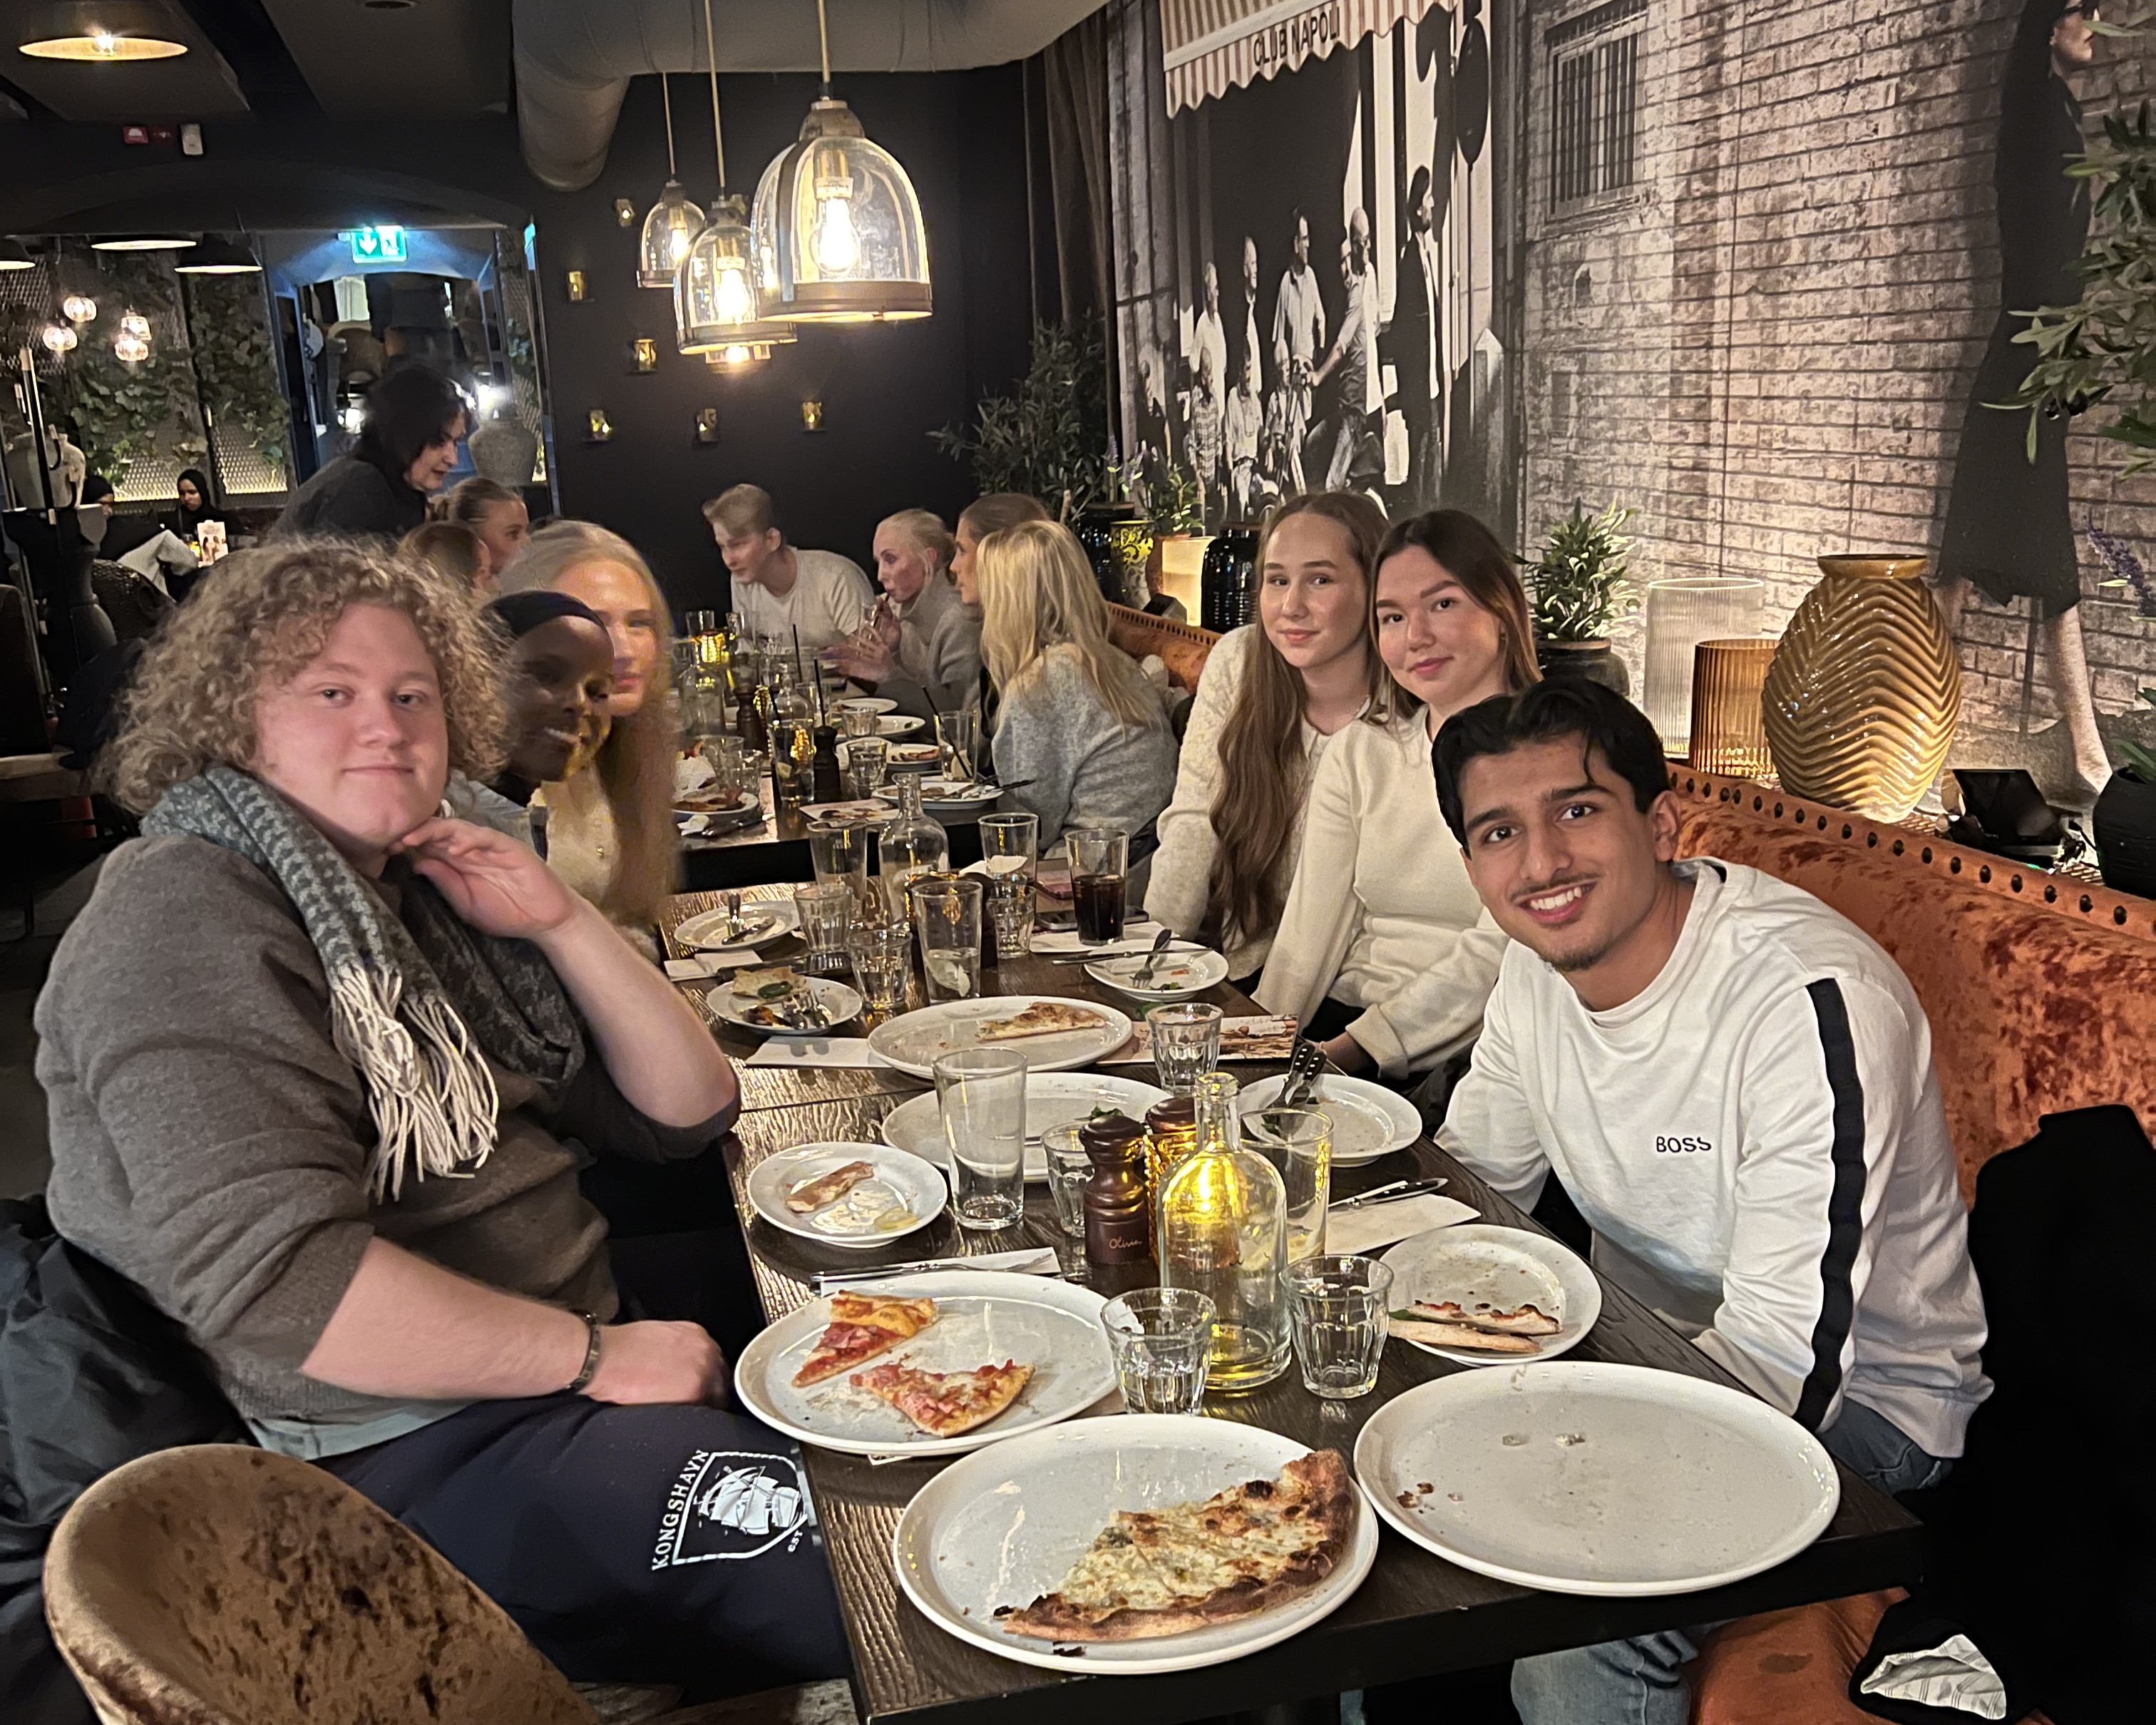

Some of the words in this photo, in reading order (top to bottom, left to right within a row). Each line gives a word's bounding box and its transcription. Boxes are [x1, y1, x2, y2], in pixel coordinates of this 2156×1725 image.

[1253, 29, 1288, 66] CLUB
[1292, 6, 1340, 55] NAPOLI
[1656, 1136, 1712, 1153] BOSS
[652, 1450, 709, 1571] KONGSHAVN
